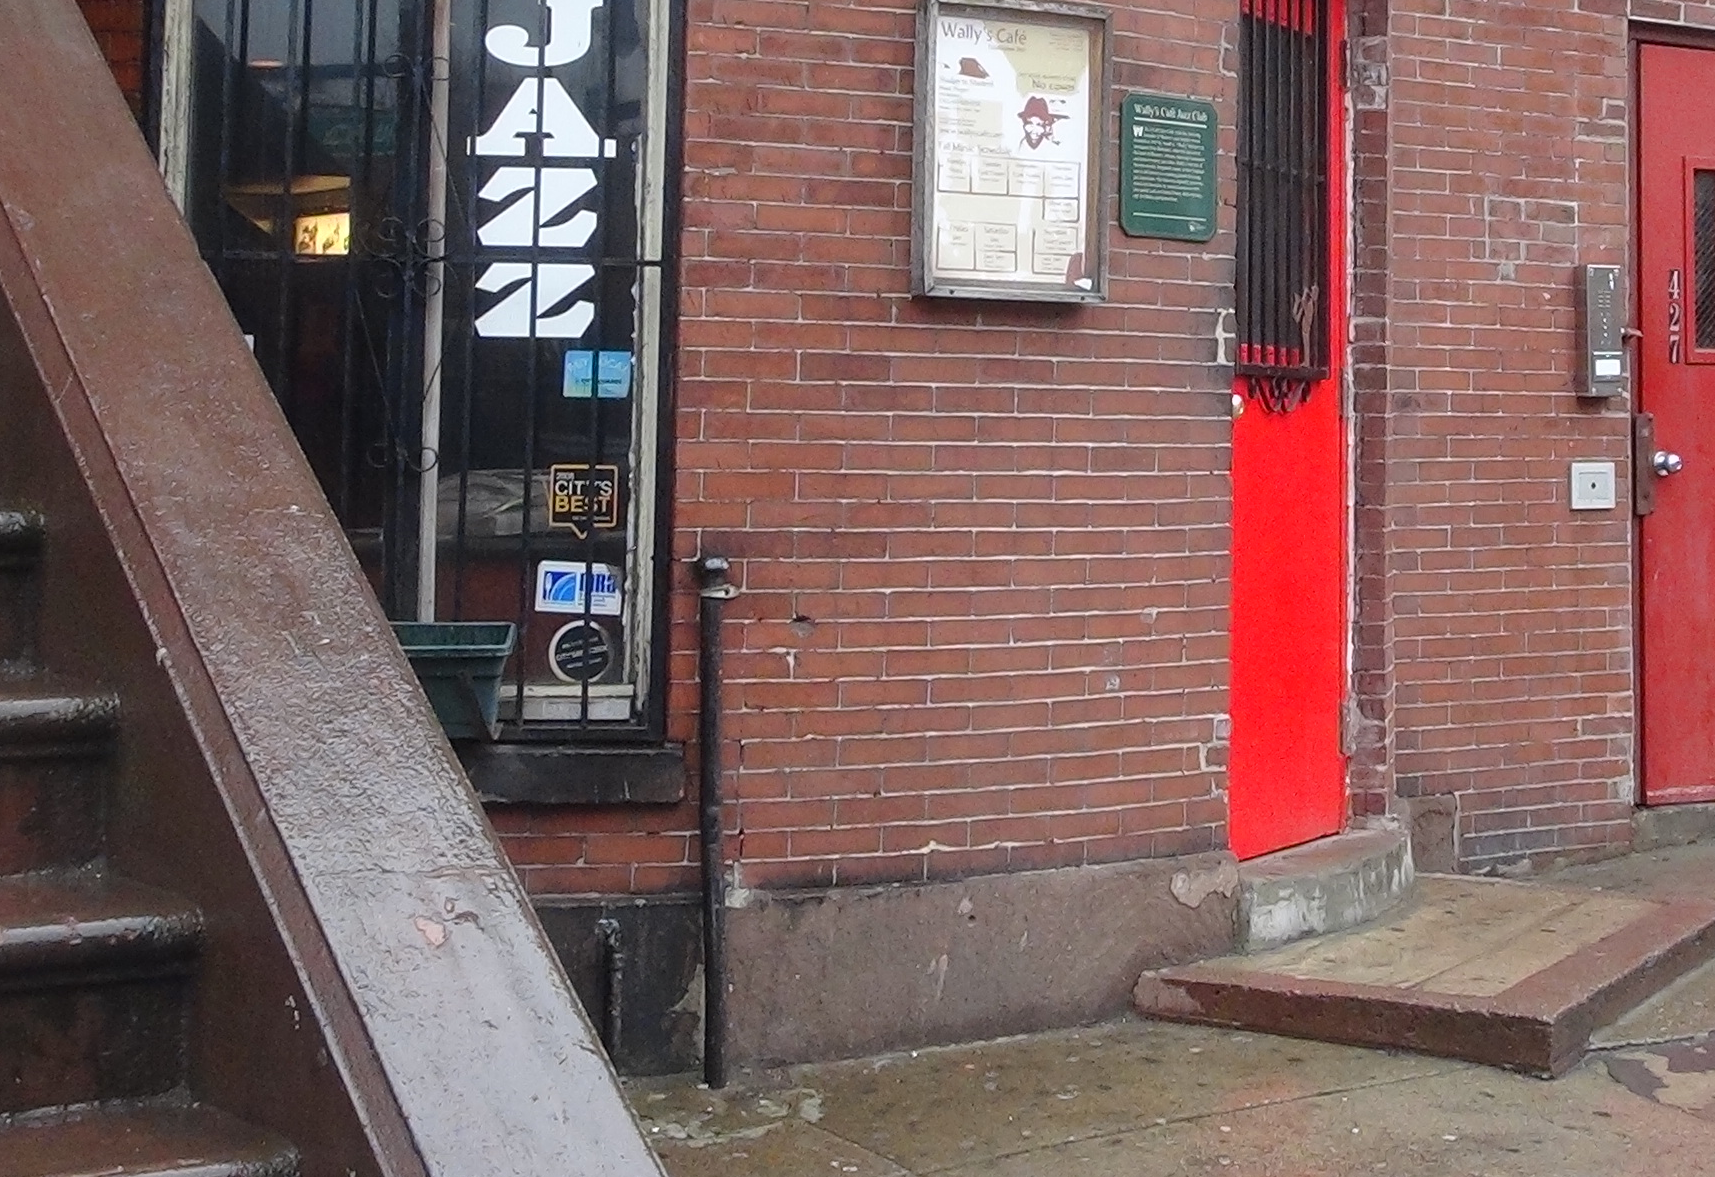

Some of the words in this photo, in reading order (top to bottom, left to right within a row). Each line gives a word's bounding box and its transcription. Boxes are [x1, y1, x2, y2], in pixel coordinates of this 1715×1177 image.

[941, 21, 992, 45] Wally's
[996, 27, 1027, 45] Café
[1668, 270, 1681, 363] 427
